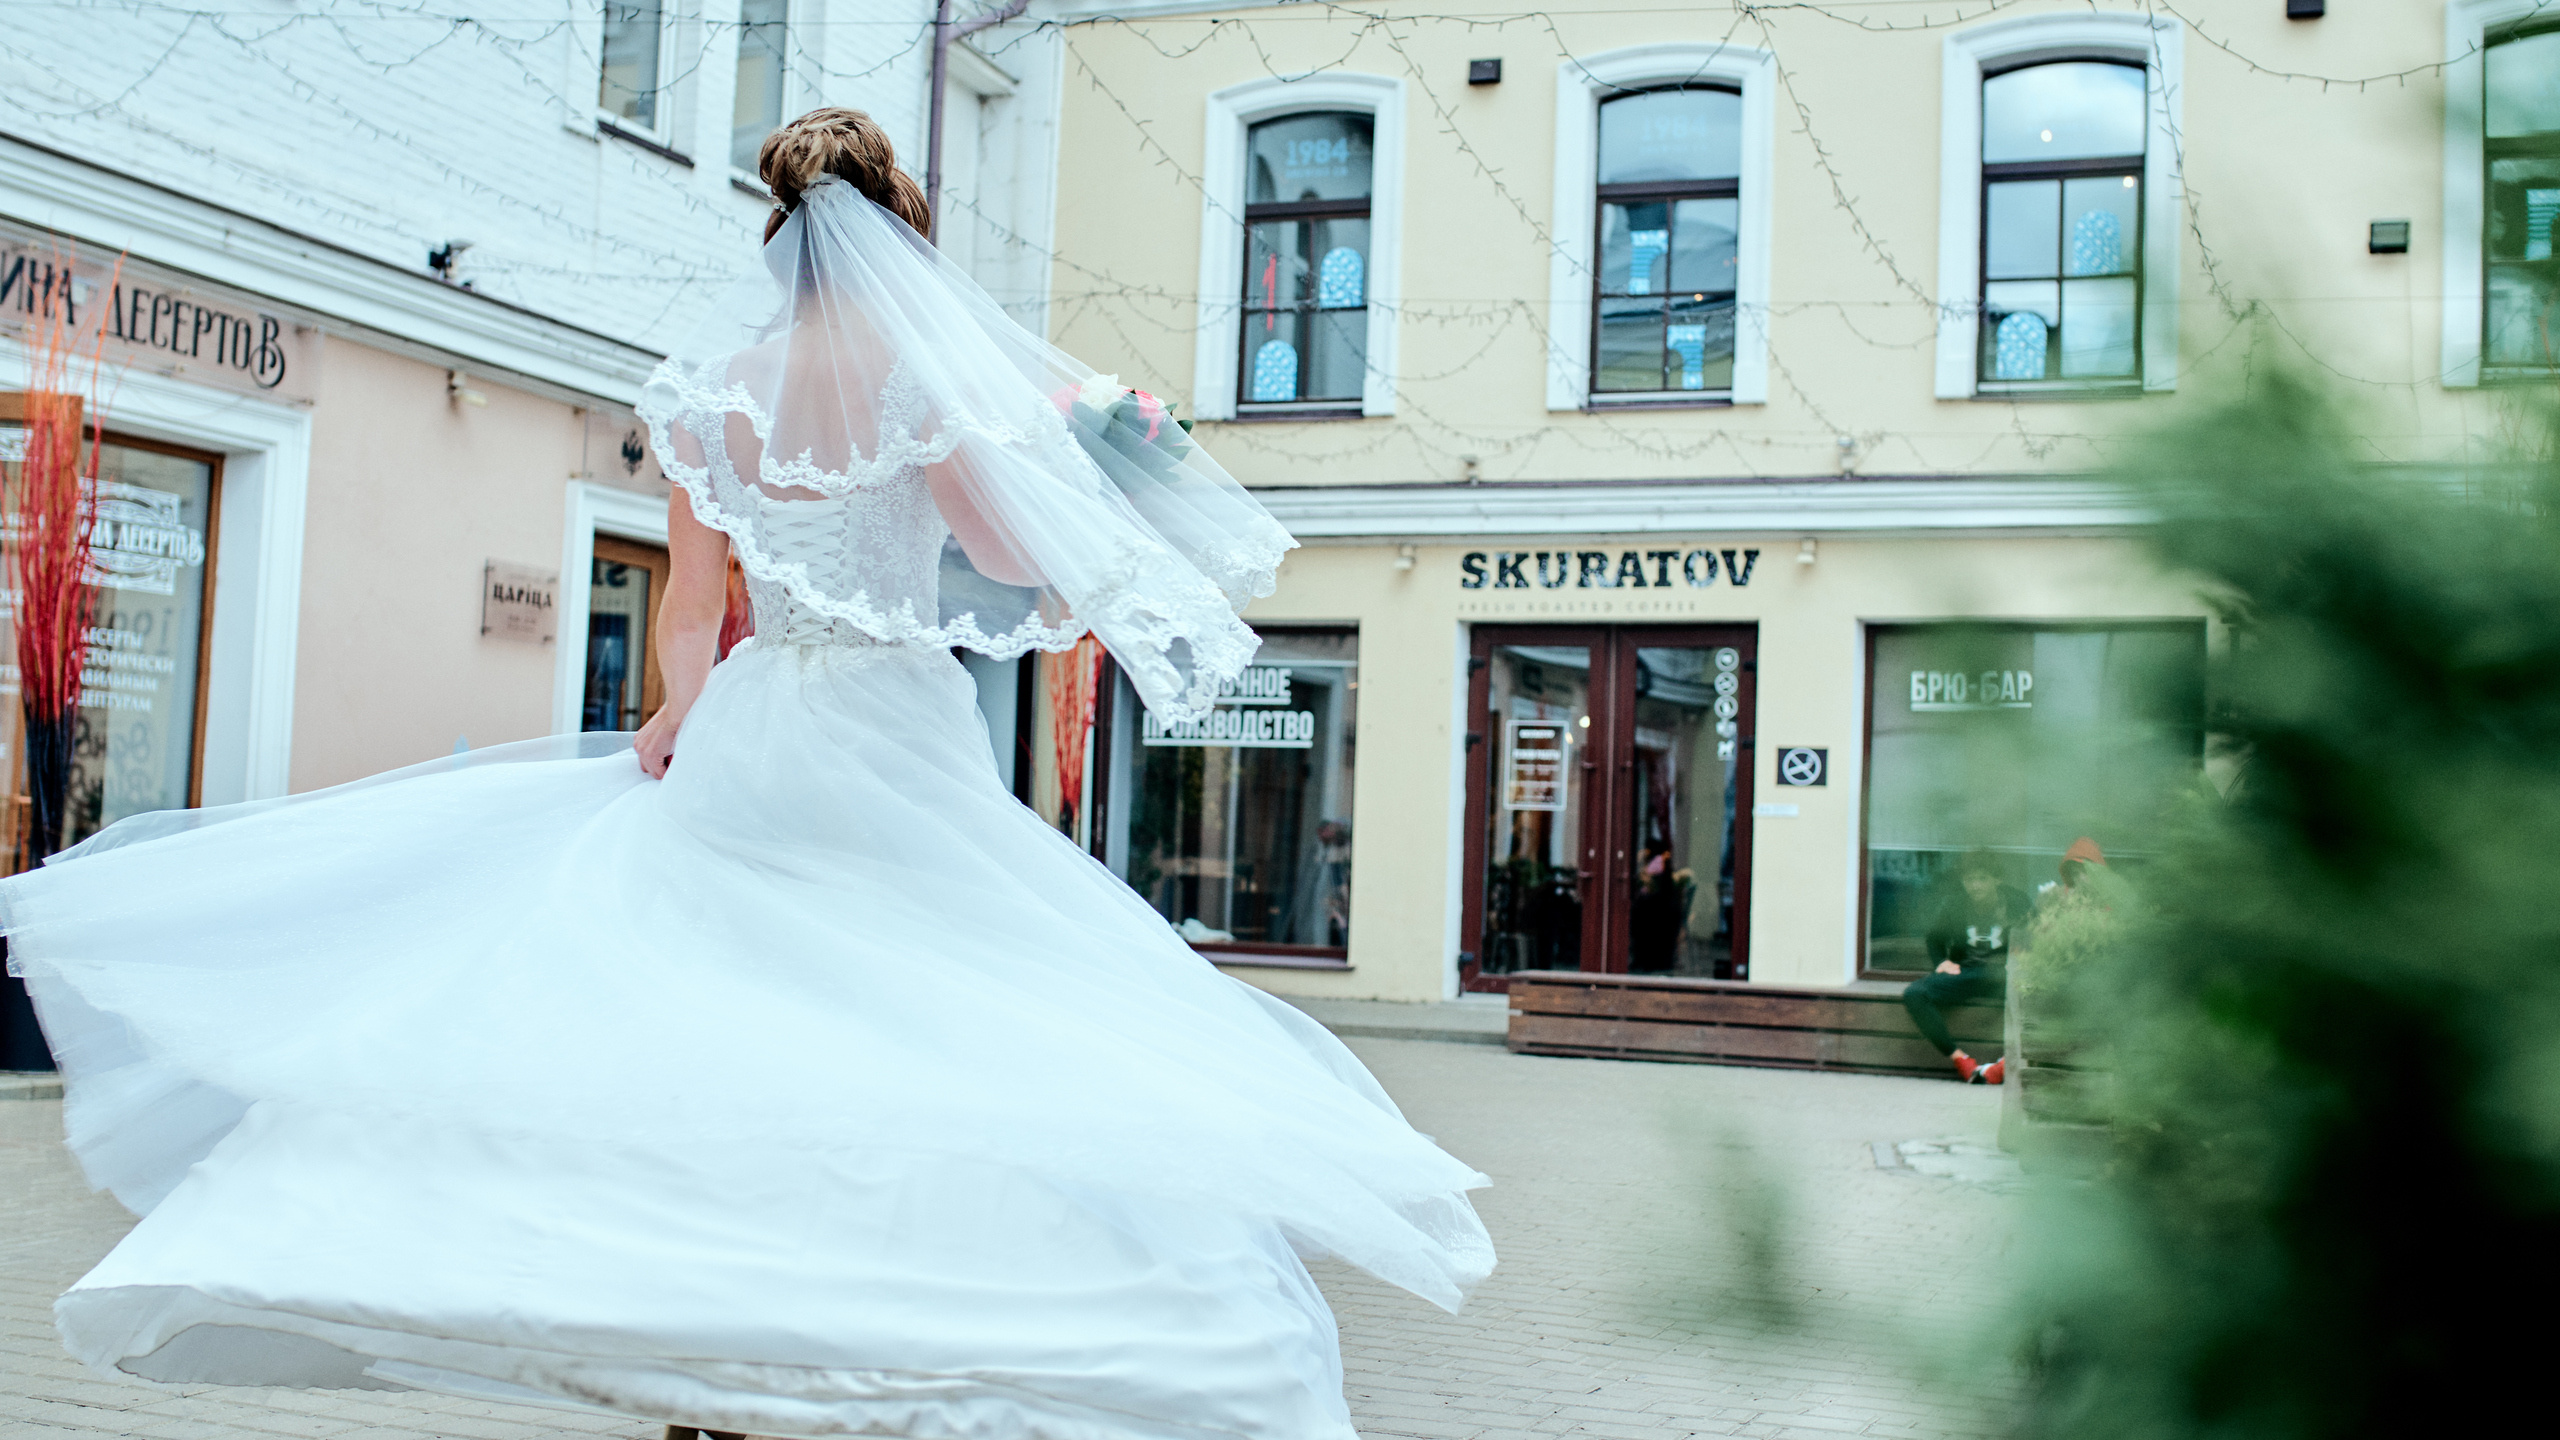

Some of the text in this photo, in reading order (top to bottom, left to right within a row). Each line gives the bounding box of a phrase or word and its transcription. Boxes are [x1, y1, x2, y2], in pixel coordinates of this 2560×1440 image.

[1285, 137, 1350, 166] 1984
[97, 281, 286, 389] ДЕСЕРТОВ
[114, 522, 205, 567] ДЕСЕРТОВ
[1461, 549, 1760, 589] SKURATOV
[72, 646, 174, 673] СТОРИЧЕСКИ
[1219, 667, 1292, 697] ОЧНОЕ
[1910, 670, 2033, 701] БРЮ-БАР
